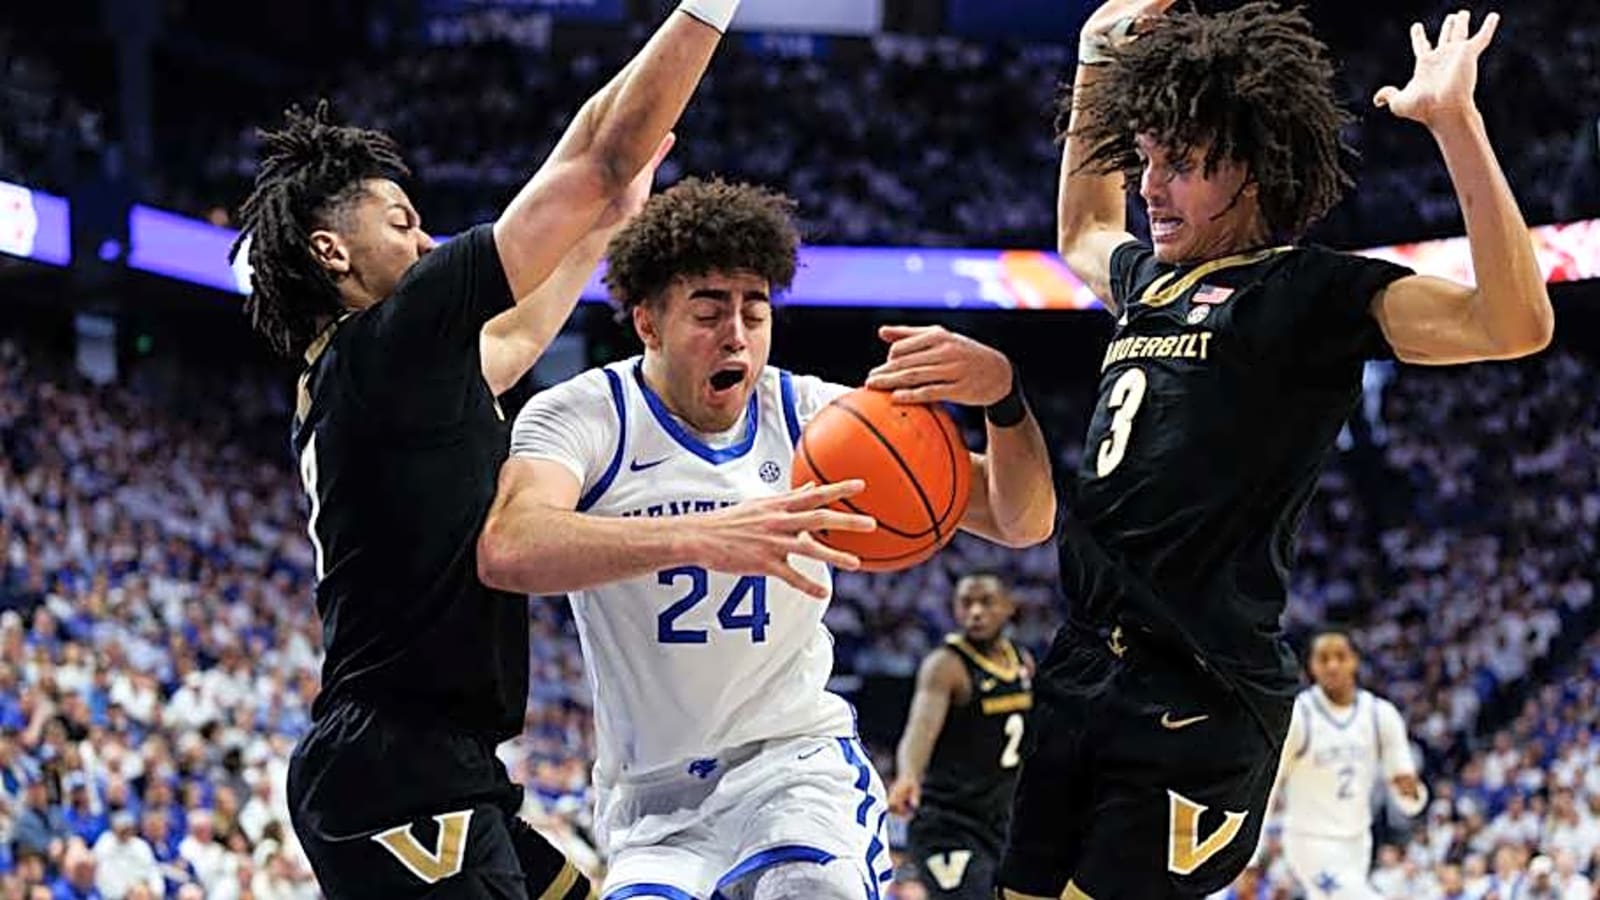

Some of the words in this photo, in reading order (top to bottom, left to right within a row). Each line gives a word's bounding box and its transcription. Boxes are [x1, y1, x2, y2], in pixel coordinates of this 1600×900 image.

[1097, 367, 1147, 478] 3
[658, 565, 770, 643] 24
[1001, 713, 1024, 768] 2
[1337, 765, 1356, 799] 2
[370, 809, 474, 884] V
[1166, 788, 1249, 875] V
[927, 849, 972, 890] V
